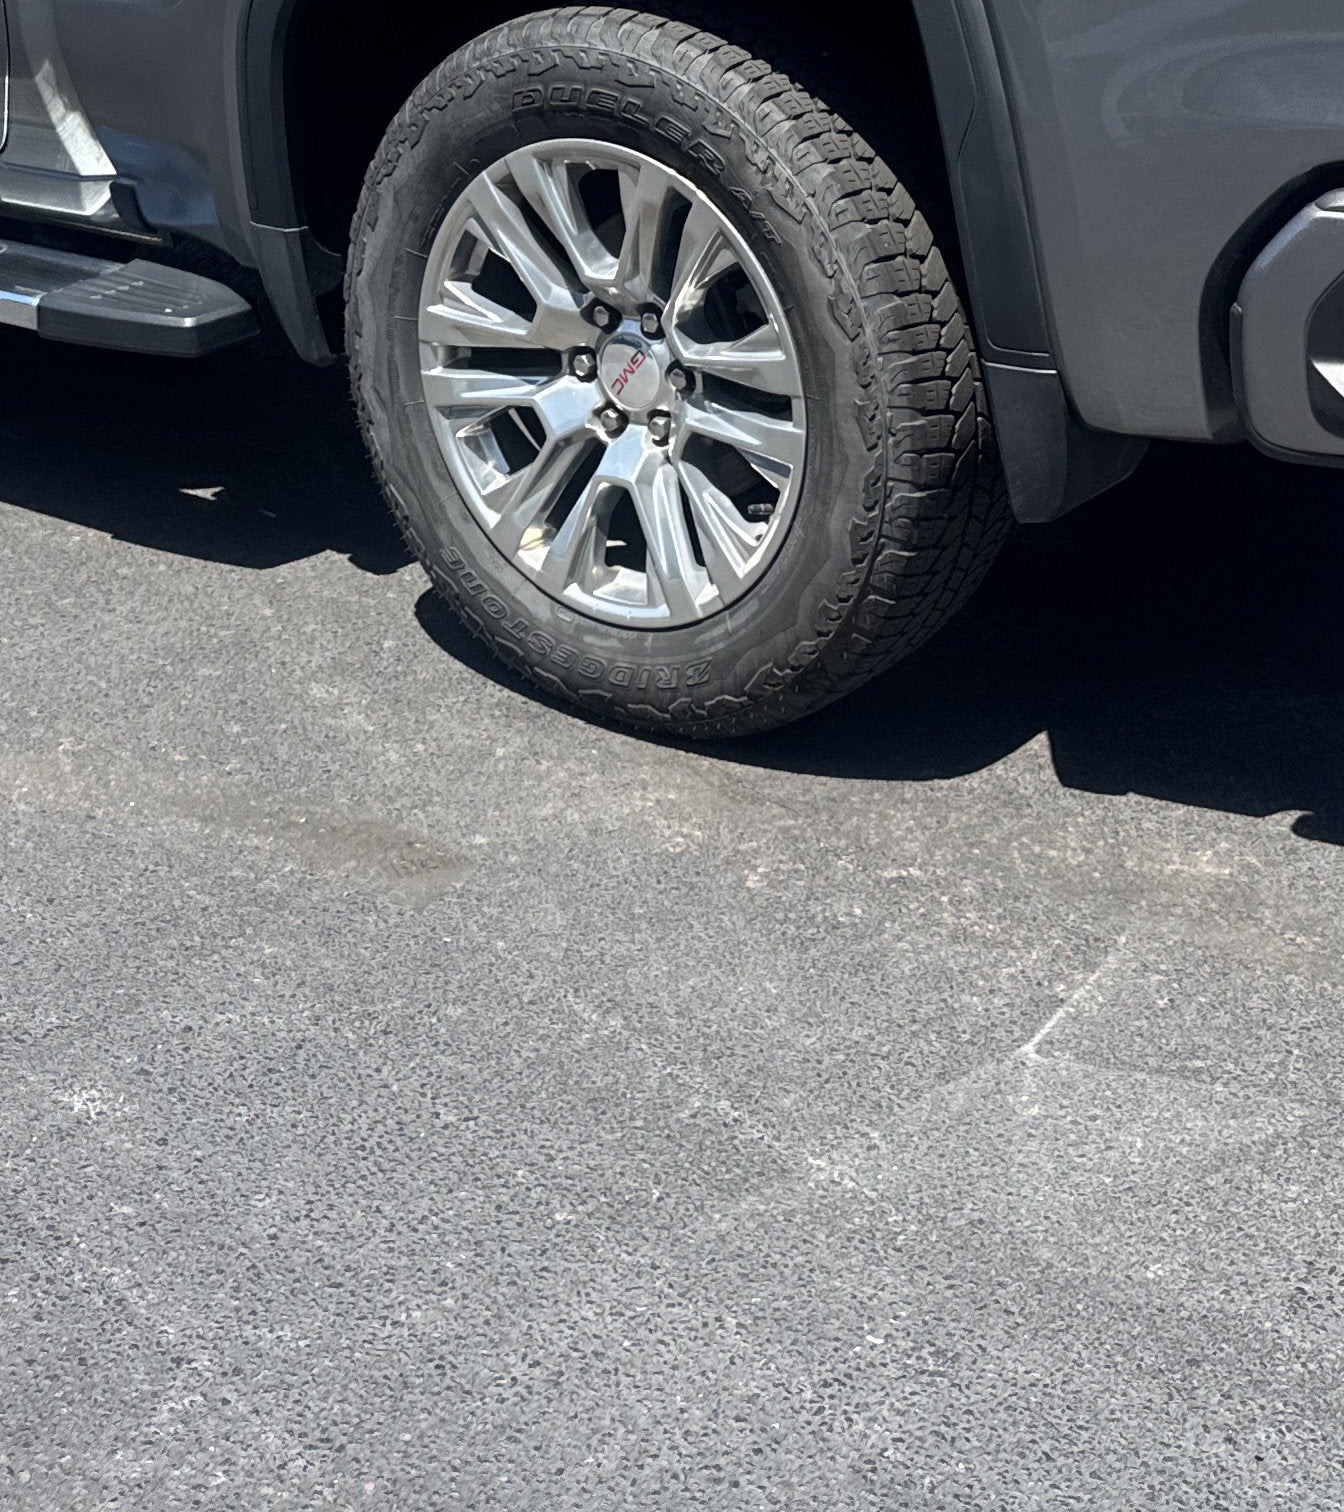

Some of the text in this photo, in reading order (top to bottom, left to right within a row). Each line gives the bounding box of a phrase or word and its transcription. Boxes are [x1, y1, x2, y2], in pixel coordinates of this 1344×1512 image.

[511, 84, 727, 178] DUELER
[611, 349, 646, 396] GMC
[439, 544, 714, 690] BRIDGESTONE
